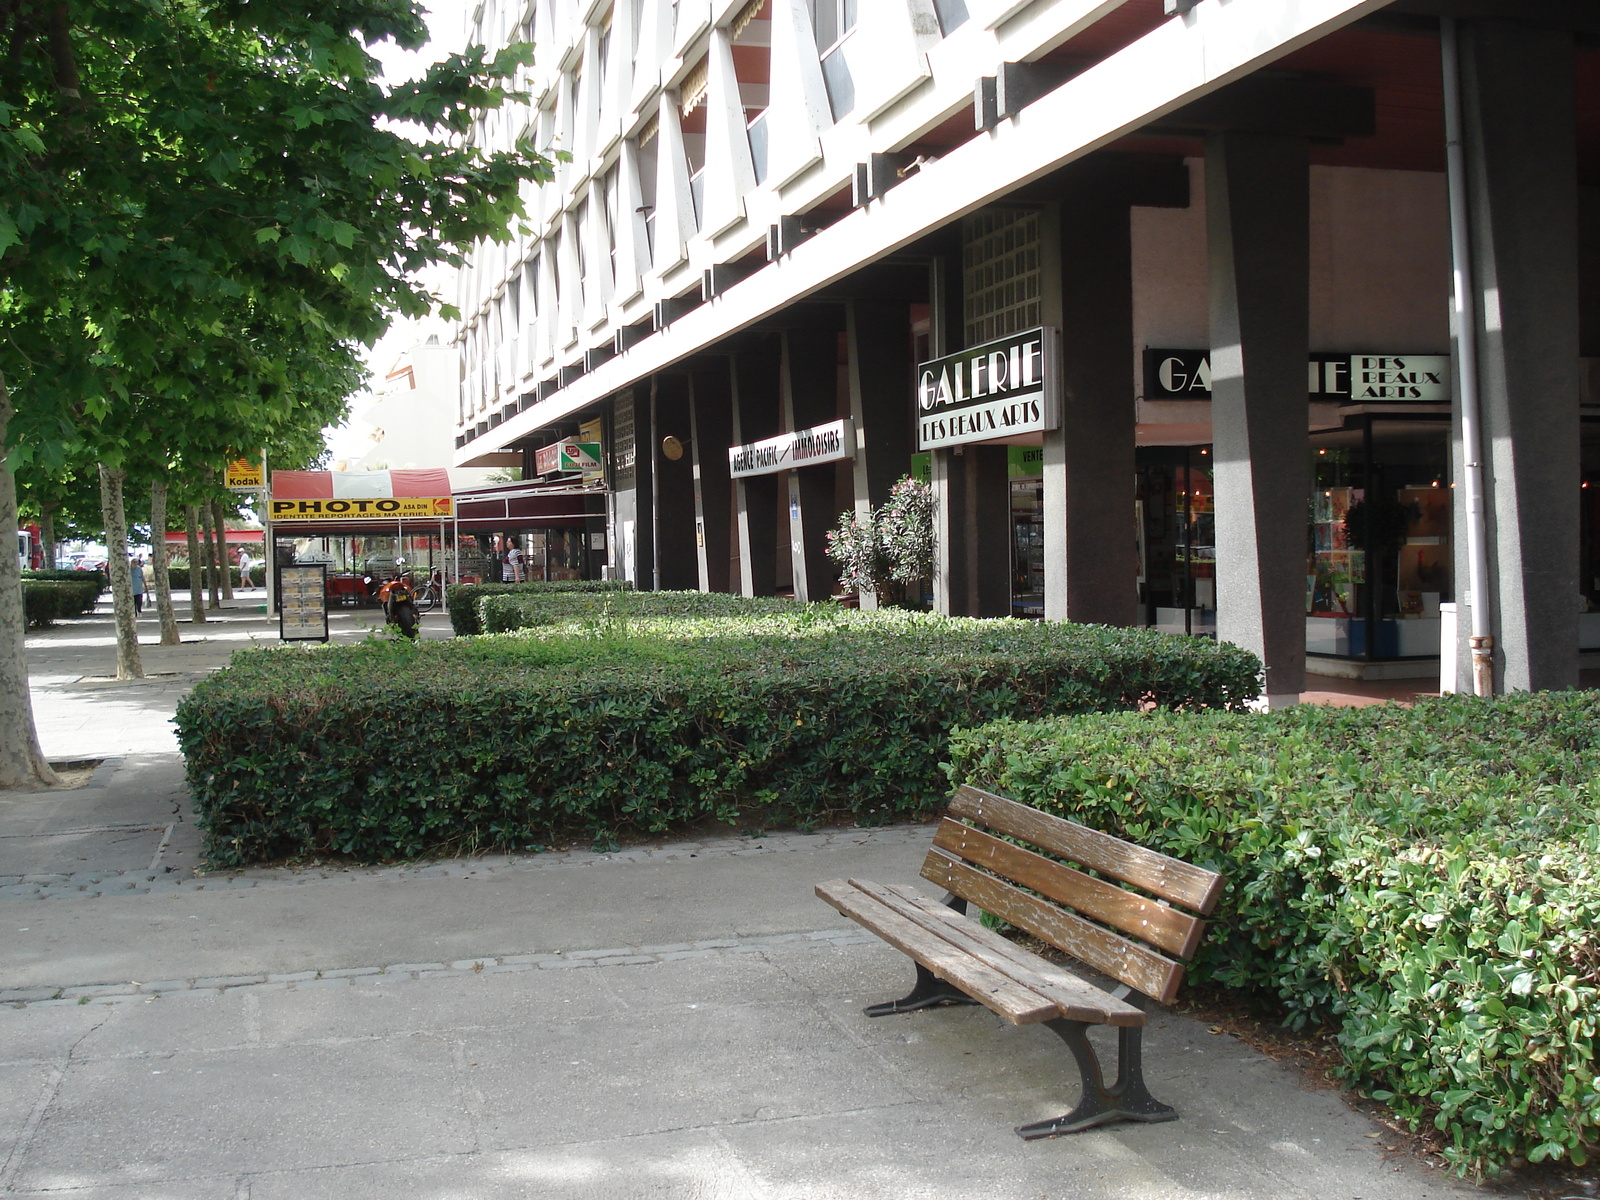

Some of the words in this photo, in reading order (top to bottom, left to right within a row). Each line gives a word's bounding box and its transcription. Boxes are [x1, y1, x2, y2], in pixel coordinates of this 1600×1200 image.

[1361, 357, 1406, 370] DES
[920, 339, 1042, 411] GALERIE
[1361, 371, 1441, 385] BEAUX
[1360, 385, 1422, 399] ARTS
[922, 418, 946, 442] DES
[949, 408, 997, 437] BEAUX
[999, 399, 1040, 427] ARTS
[733, 449, 754, 473] AGENCE
[756, 444, 778, 469] PACIFIC
[791, 429, 840, 462] IMMOLOISIRS
[229, 477, 260, 486] Kodak
[273, 500, 401, 514] PHOTO
